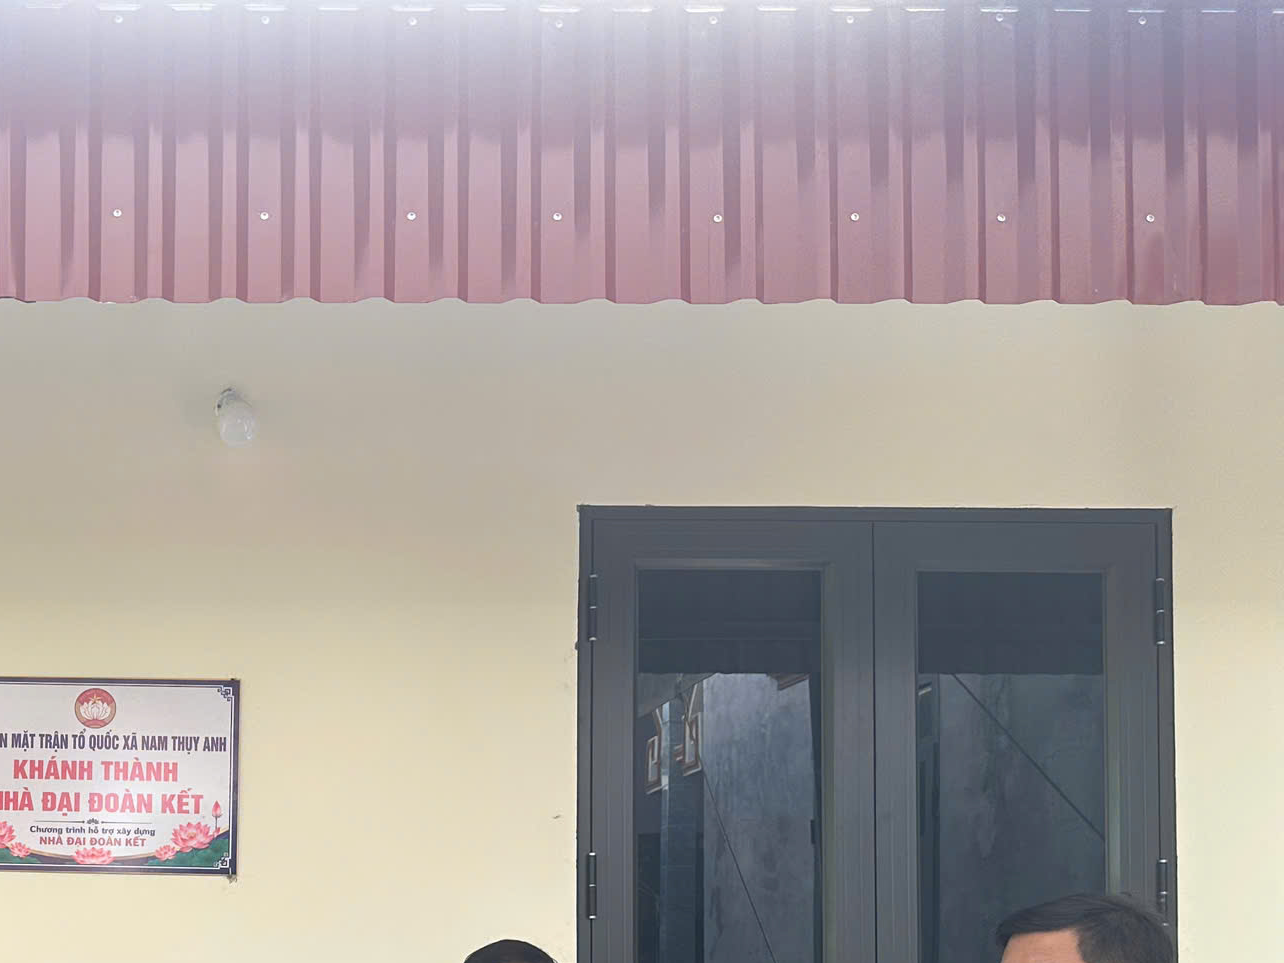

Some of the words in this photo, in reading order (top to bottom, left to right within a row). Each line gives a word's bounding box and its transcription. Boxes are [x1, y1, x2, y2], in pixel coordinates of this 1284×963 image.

[11, 730, 36, 752] MẶT
[39, 731, 68, 752] TRẬN
[72, 728, 87, 749] TỔ
[89, 729, 119, 750] QUỐC
[122, 732, 138, 750] XÃ
[141, 736, 167, 751] NAM
[171, 736, 200, 754] THỤY
[203, 737, 227, 752] ANH
[13, 756, 93, 780] KHÁNH
[101, 757, 178, 782] THÀNH
[41, 792, 80, 816] ĐẠI
[88, 789, 153, 813] ĐOÀN
[161, 788, 204, 814] KẾT
[29, 825, 63, 835] Chương
[101, 827, 115, 837] trợ
[116, 827, 132, 836] xây
[134, 827, 156, 837] dựng
[39, 834, 63, 845] NHÀ
[89, 834, 122, 846] ĐOÀN
[125, 835, 146, 847] KẾT
